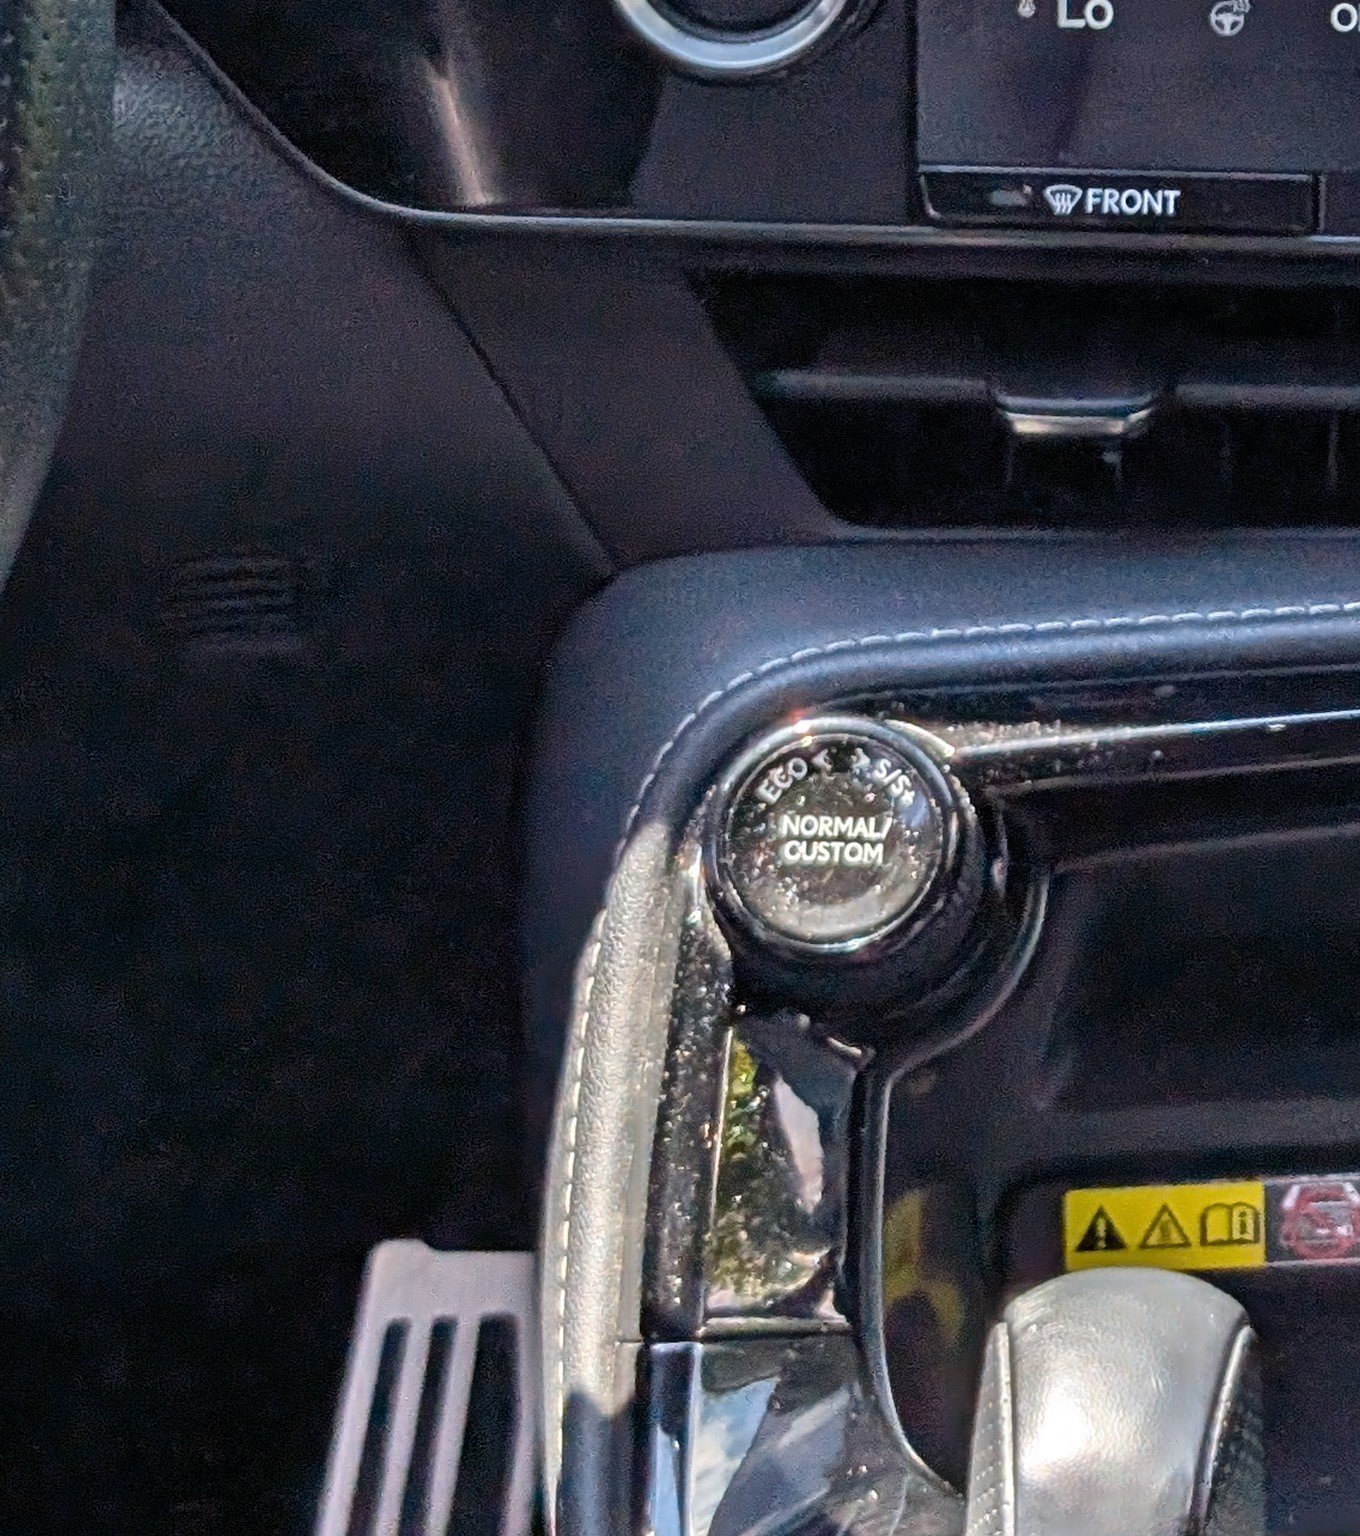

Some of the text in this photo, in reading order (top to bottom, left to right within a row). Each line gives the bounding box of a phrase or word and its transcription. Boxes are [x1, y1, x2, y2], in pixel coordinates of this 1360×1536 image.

[1086, 189, 1181, 217] FRONT
[756, 757, 808, 804] ECO
[781, 816, 893, 841] NORMAL/
[784, 841, 884, 865] CUSTOM
